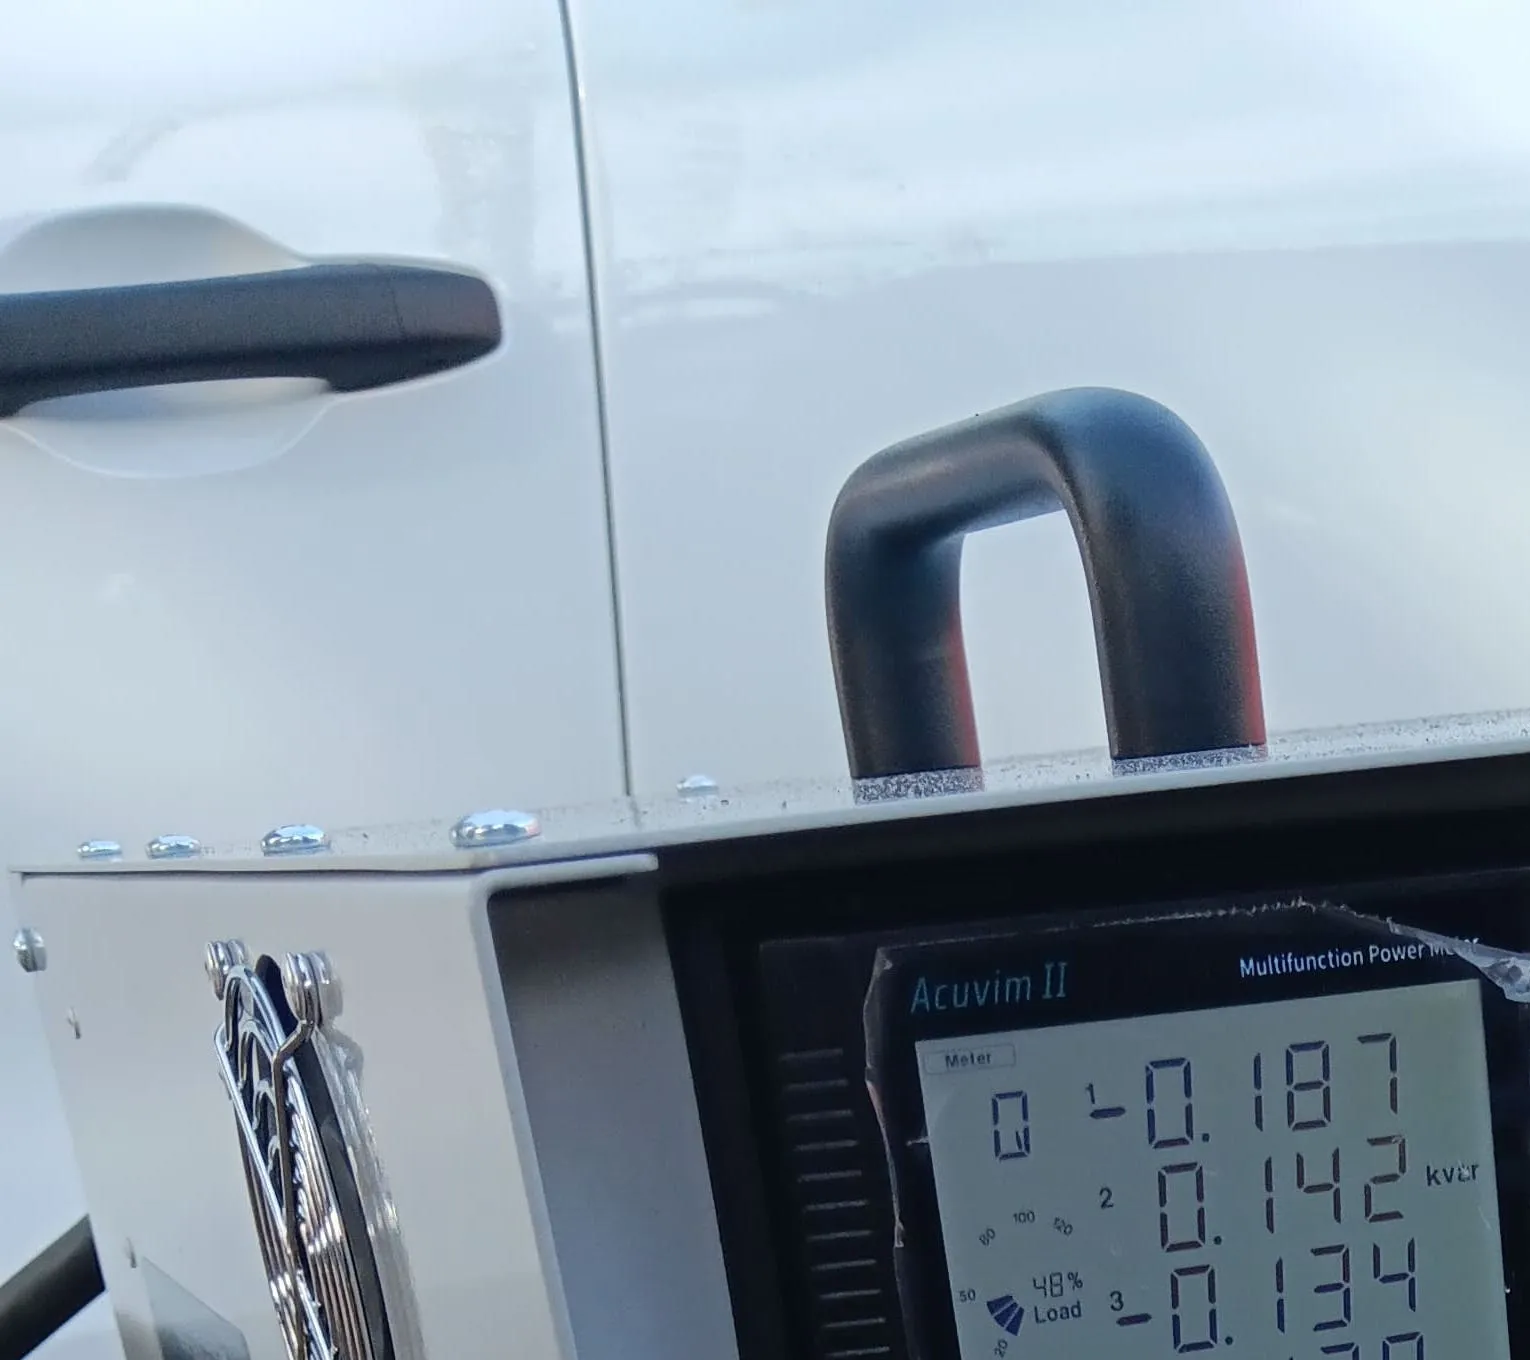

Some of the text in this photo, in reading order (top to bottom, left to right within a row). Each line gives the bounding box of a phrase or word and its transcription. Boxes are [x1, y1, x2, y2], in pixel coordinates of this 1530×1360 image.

[1240, 949, 1363, 978] Multifunction
[1369, 944, 1425, 963] Power
[910, 961, 1067, 1013] Acuvim II
[945, 1052, 991, 1068] Meter
[1100, 1188, 1114, 1209] 2
[1158, 1135, 1406, 1252] 0.142
[1013, 1211, 1035, 1224] 100
[1034, 1301, 1082, 1324] Load
[1110, 1291, 1124, 1311] 3
